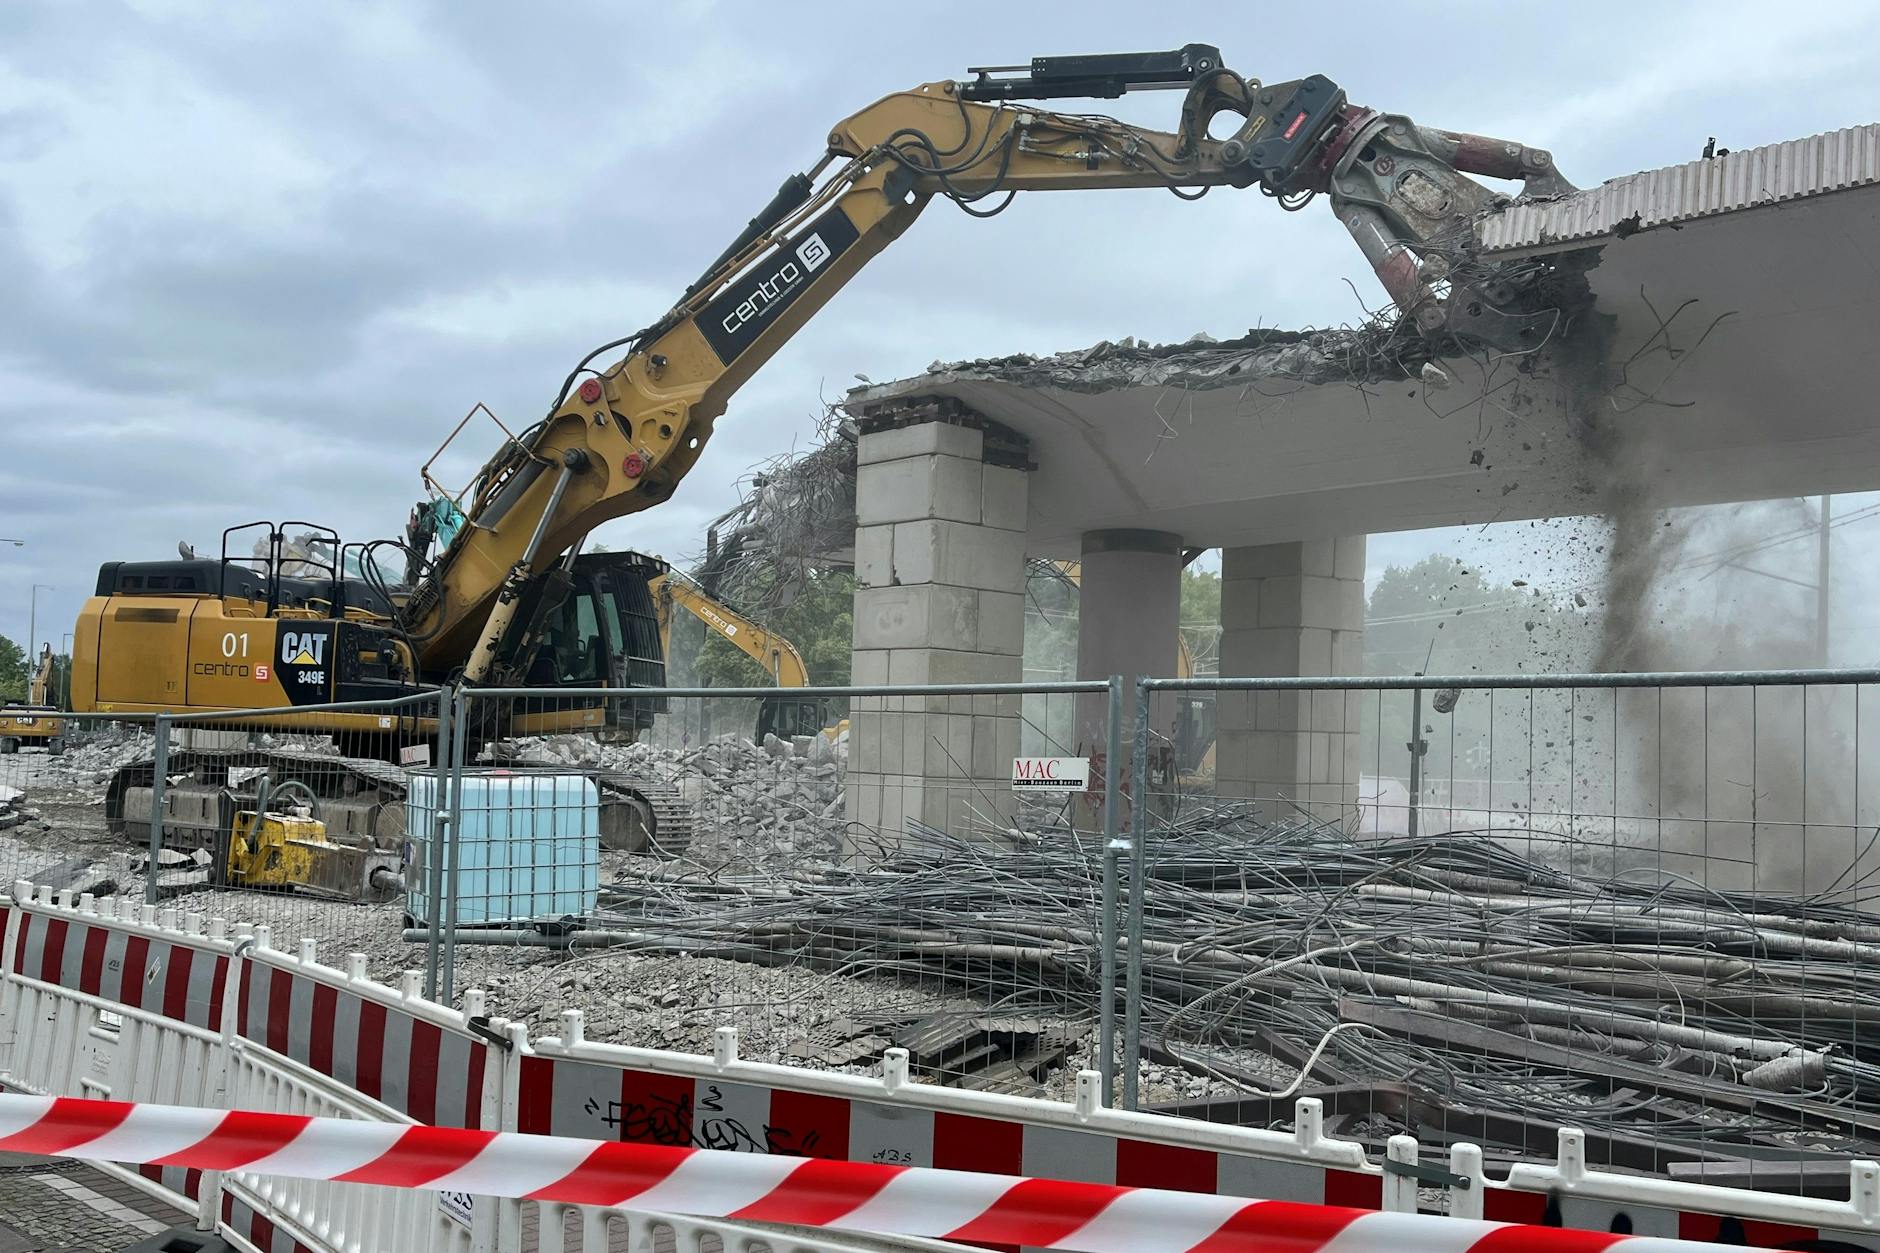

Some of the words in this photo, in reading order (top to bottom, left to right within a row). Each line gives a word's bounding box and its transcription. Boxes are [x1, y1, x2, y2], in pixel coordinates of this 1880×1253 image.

[722, 262, 799, 334] centro
[222, 632, 249, 658] 01
[281, 631, 328, 665] CAT
[194, 661, 249, 677] centro
[298, 671, 325, 685] 349E
[1014, 759, 1060, 779] MAC
[872, 1148, 912, 1162] ABS
